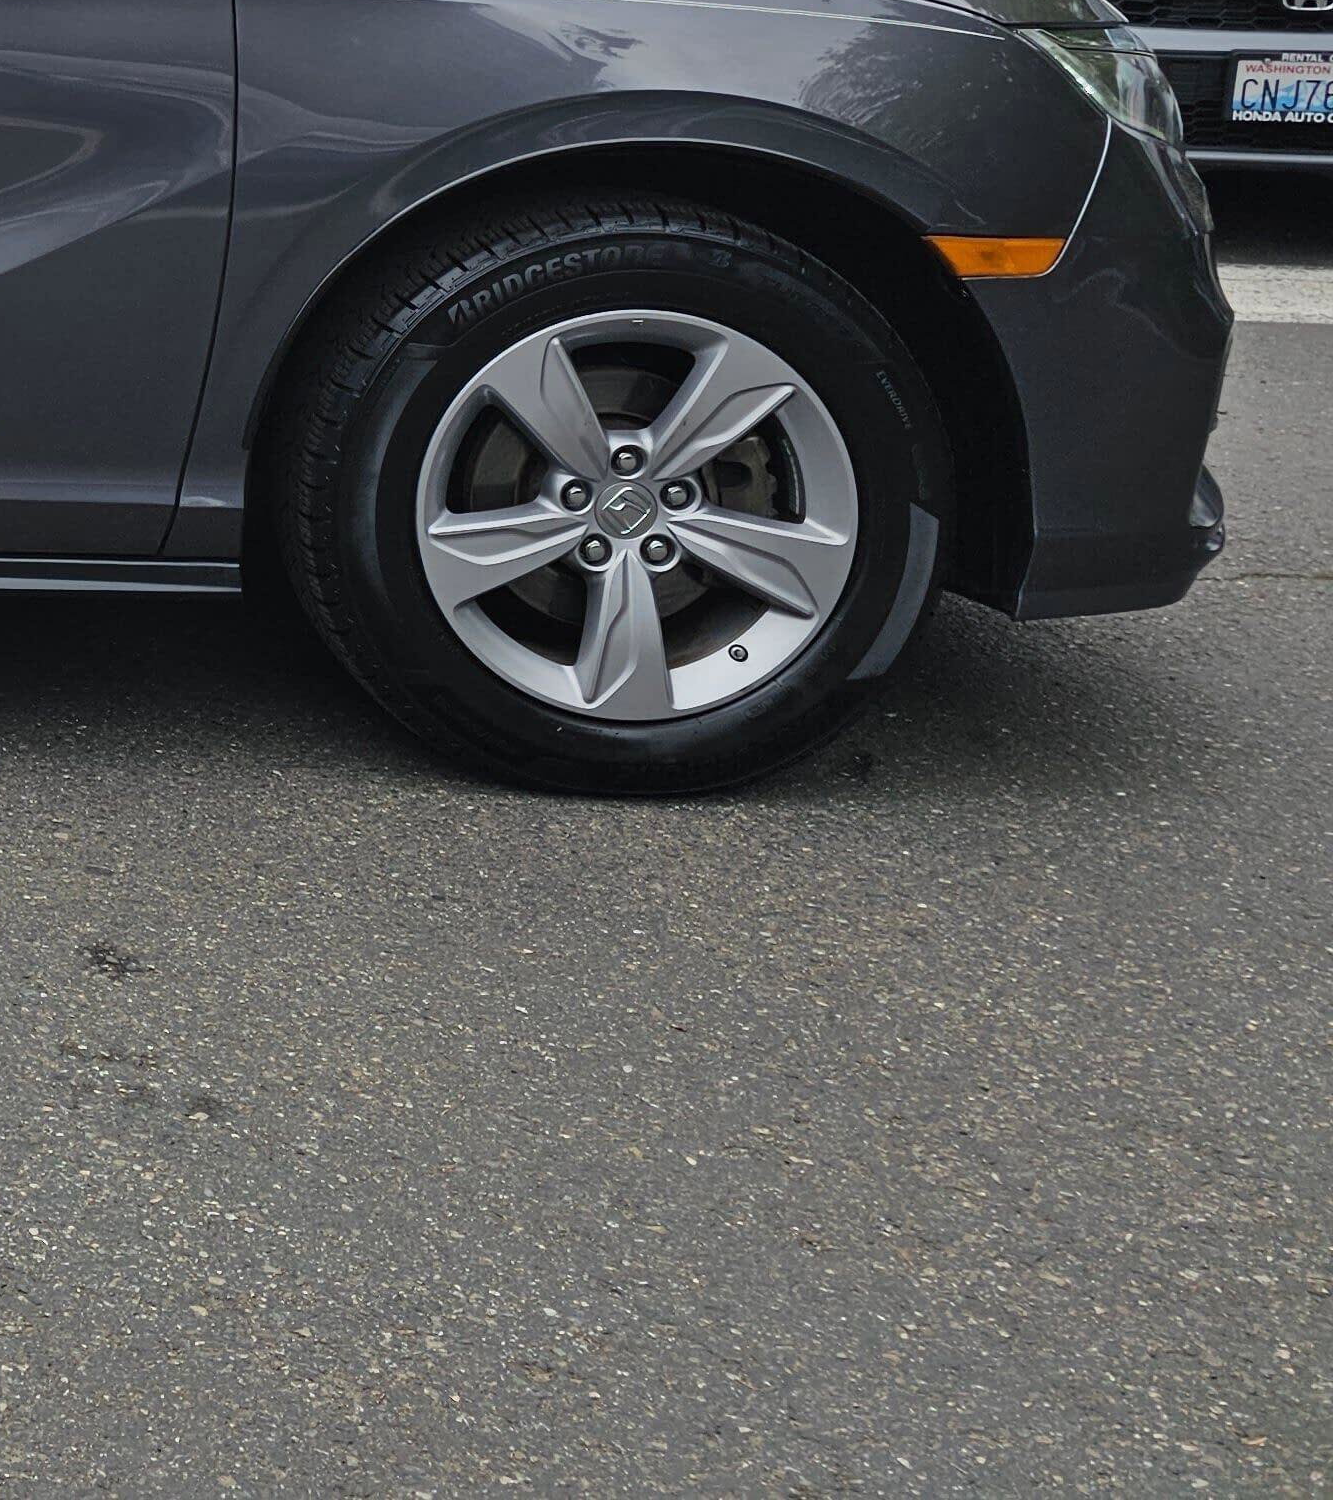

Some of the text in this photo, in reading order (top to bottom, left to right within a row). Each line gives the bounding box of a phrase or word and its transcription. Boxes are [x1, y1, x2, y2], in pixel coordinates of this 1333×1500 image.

[1281, 52, 1323, 62] RENTAL
[1246, 64, 1331, 74] WASHINGTON
[1232, 110, 1282, 121] HONDA
[1284, 112, 1325, 122] AUTO
